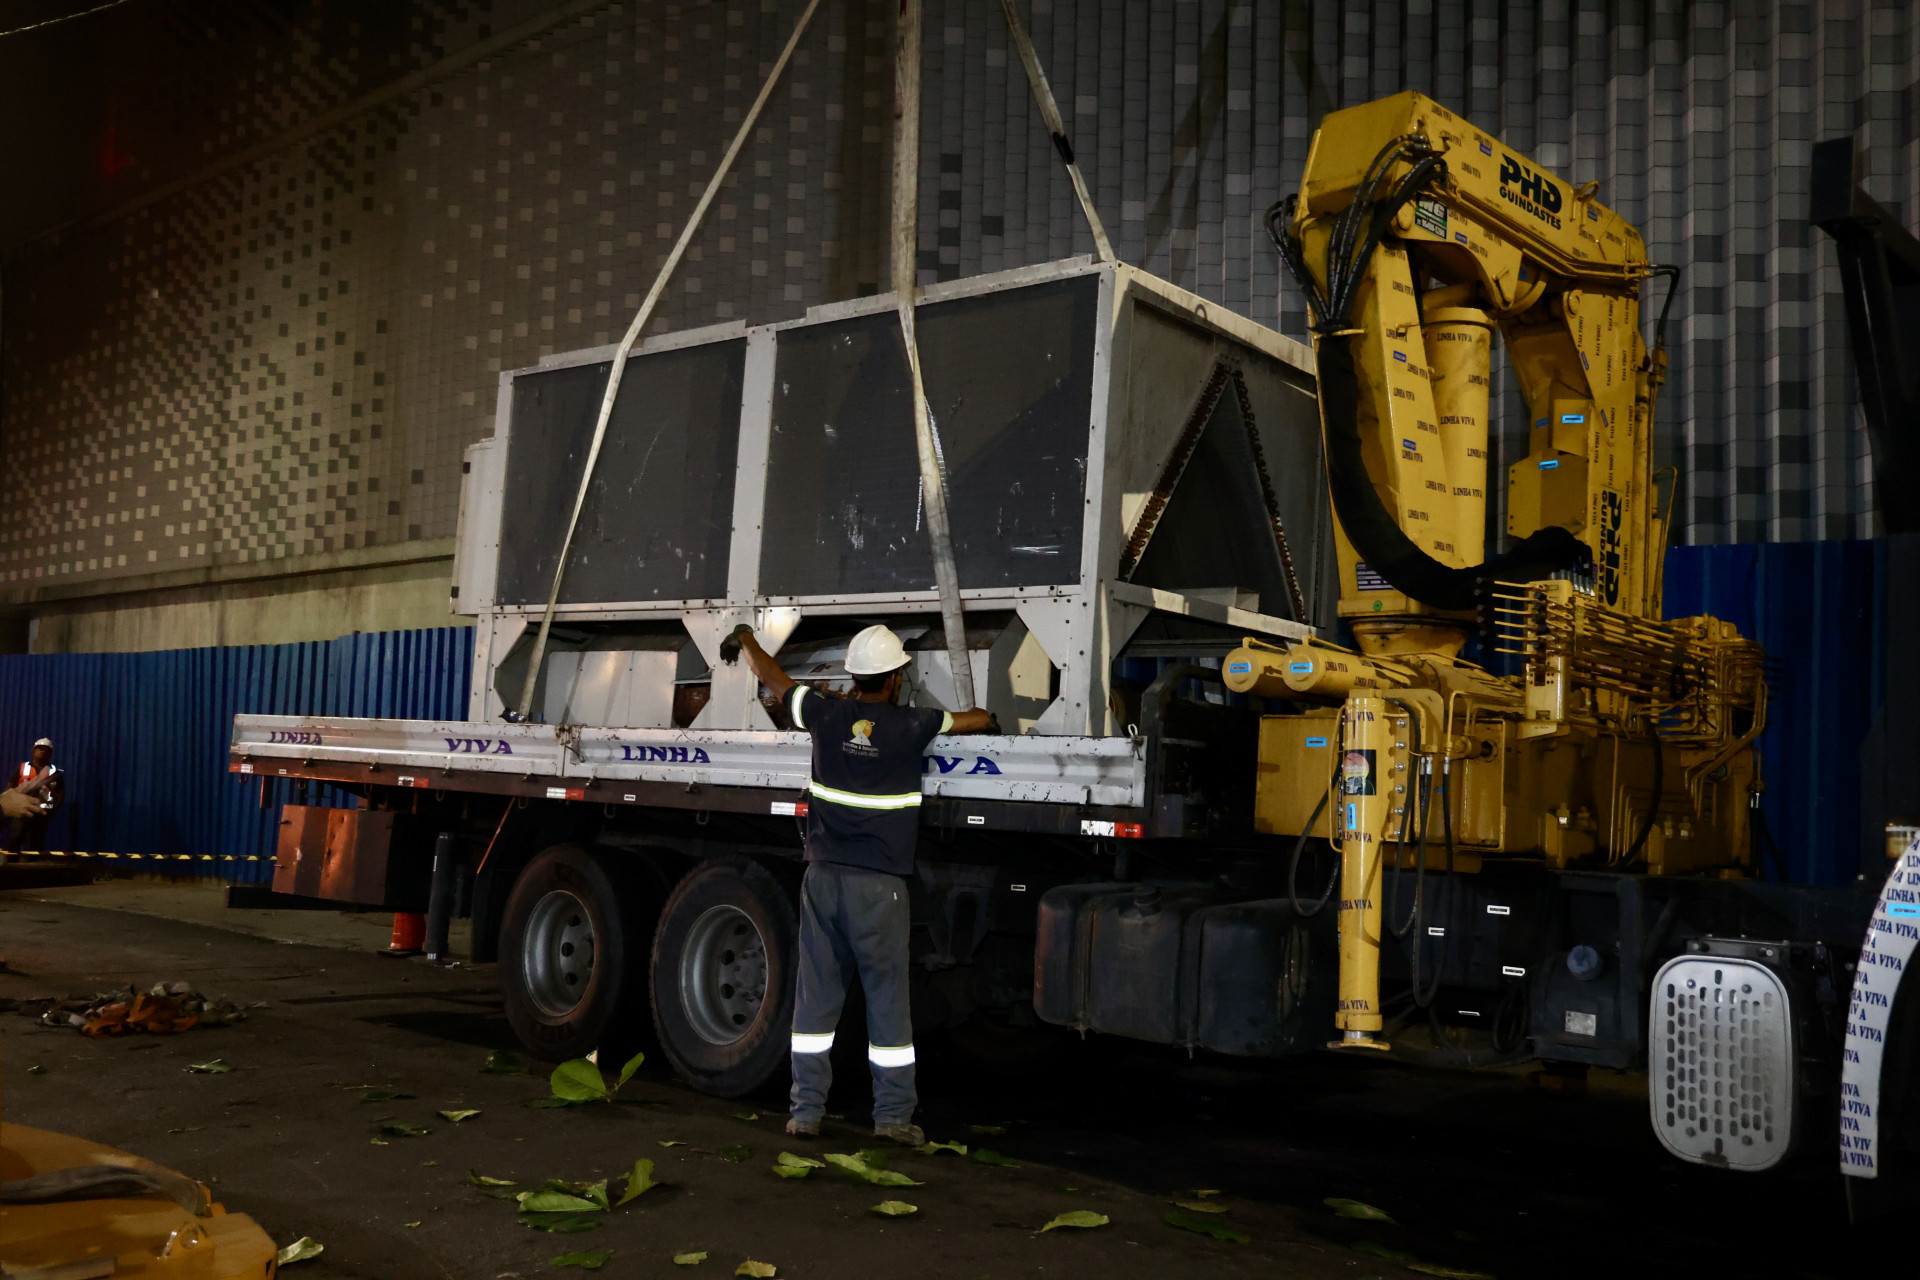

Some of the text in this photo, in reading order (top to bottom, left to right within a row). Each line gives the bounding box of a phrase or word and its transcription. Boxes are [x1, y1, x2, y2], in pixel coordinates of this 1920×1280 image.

[1500, 153, 1562, 214] PHD
[1418, 200, 1445, 218] MG
[1499, 186, 1561, 230] GUINDASTES
[1437, 333, 1472, 342] LINHA VIVA
[1440, 416, 1475, 426] LINHA VIVA
[1453, 486, 1483, 498] LINHA VIVA
[1597, 490, 1607, 603] GUINDASTES
[1605, 491, 1622, 607] PHD
[269, 730, 513, 755] LINHA VIVA
[621, 745, 712, 764] LINHA
[1907, 855, 1920, 867] LIN
[1887, 888, 1915, 903] LINHA
[1896, 923, 1919, 940] VIVA
[1879, 954, 1902, 970] VIVA
[1865, 991, 1888, 1008] VIVA
[1859, 1026, 1882, 1042] VIVA
[1848, 1100, 1871, 1117] VIVA
[1850, 1152, 1874, 1168] VIVA
